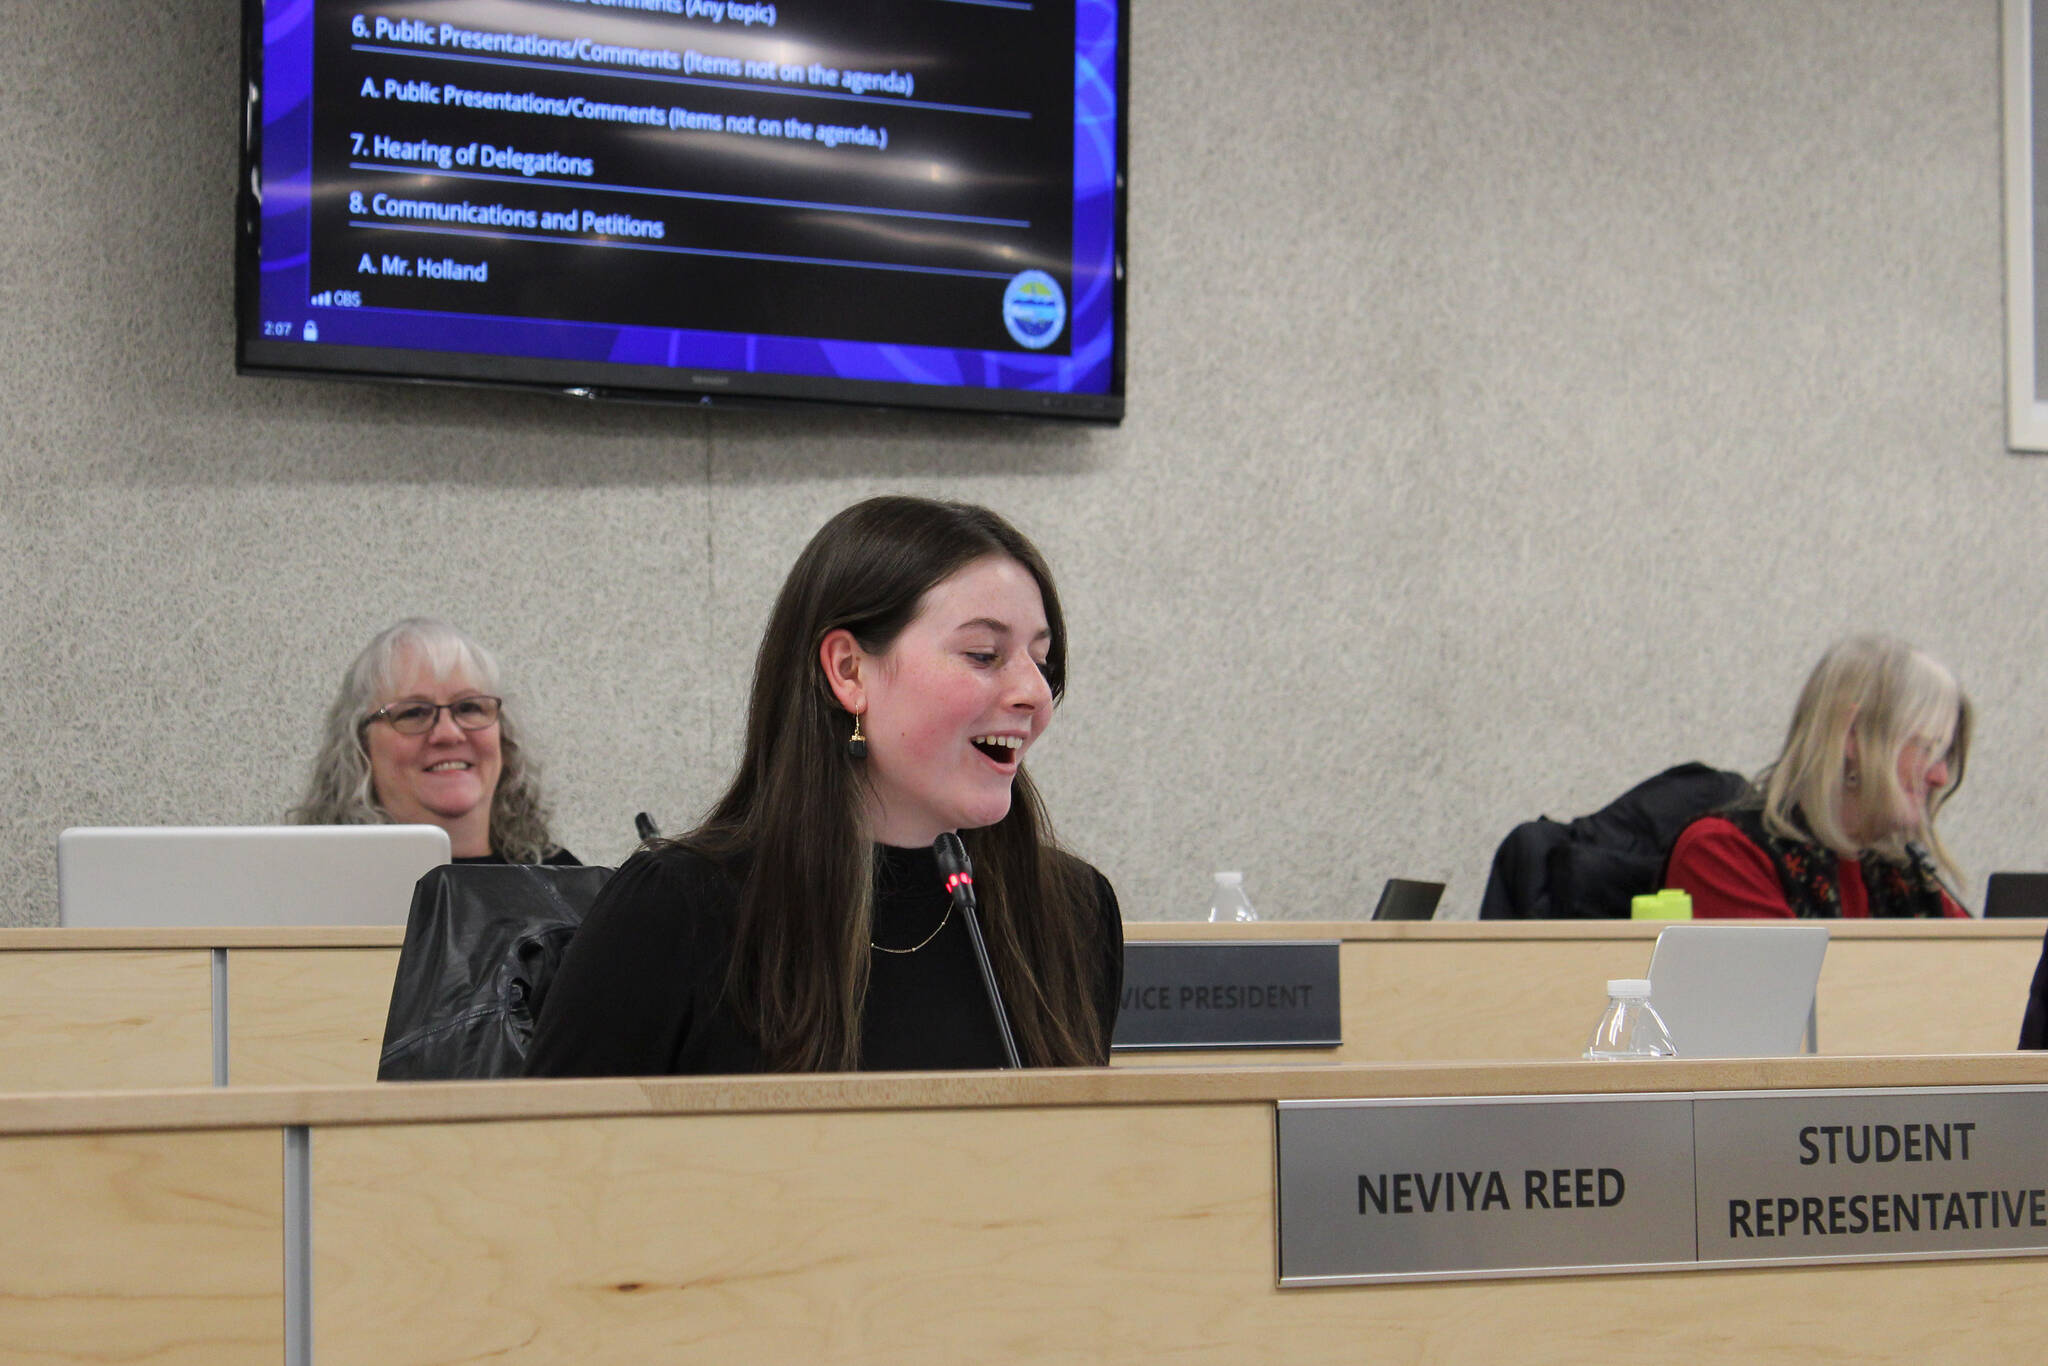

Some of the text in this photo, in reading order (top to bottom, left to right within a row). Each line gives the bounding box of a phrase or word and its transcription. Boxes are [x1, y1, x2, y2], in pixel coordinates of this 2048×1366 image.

[727, 1, 776, 27] topic)
[351, 14, 914, 97] 6. Public Presentations/Comments (Items not on the agenda)
[360, 76, 888, 150] A. Public Presentations/Comments (Items not on the agenda.)
[350, 132, 594, 176] 7. Hearing of Delegations
[349, 191, 665, 239] 8. Communications and Petitions
[358, 253, 488, 283] A. Mr. Holland
[1180, 984, 1313, 1010] PRESIDENT
[1799, 1122, 1976, 1165] STUDENT
[1357, 1167, 1626, 1214] NEVIYA REED
[1729, 1189, 2048, 1238] REPRESENTATIVE
